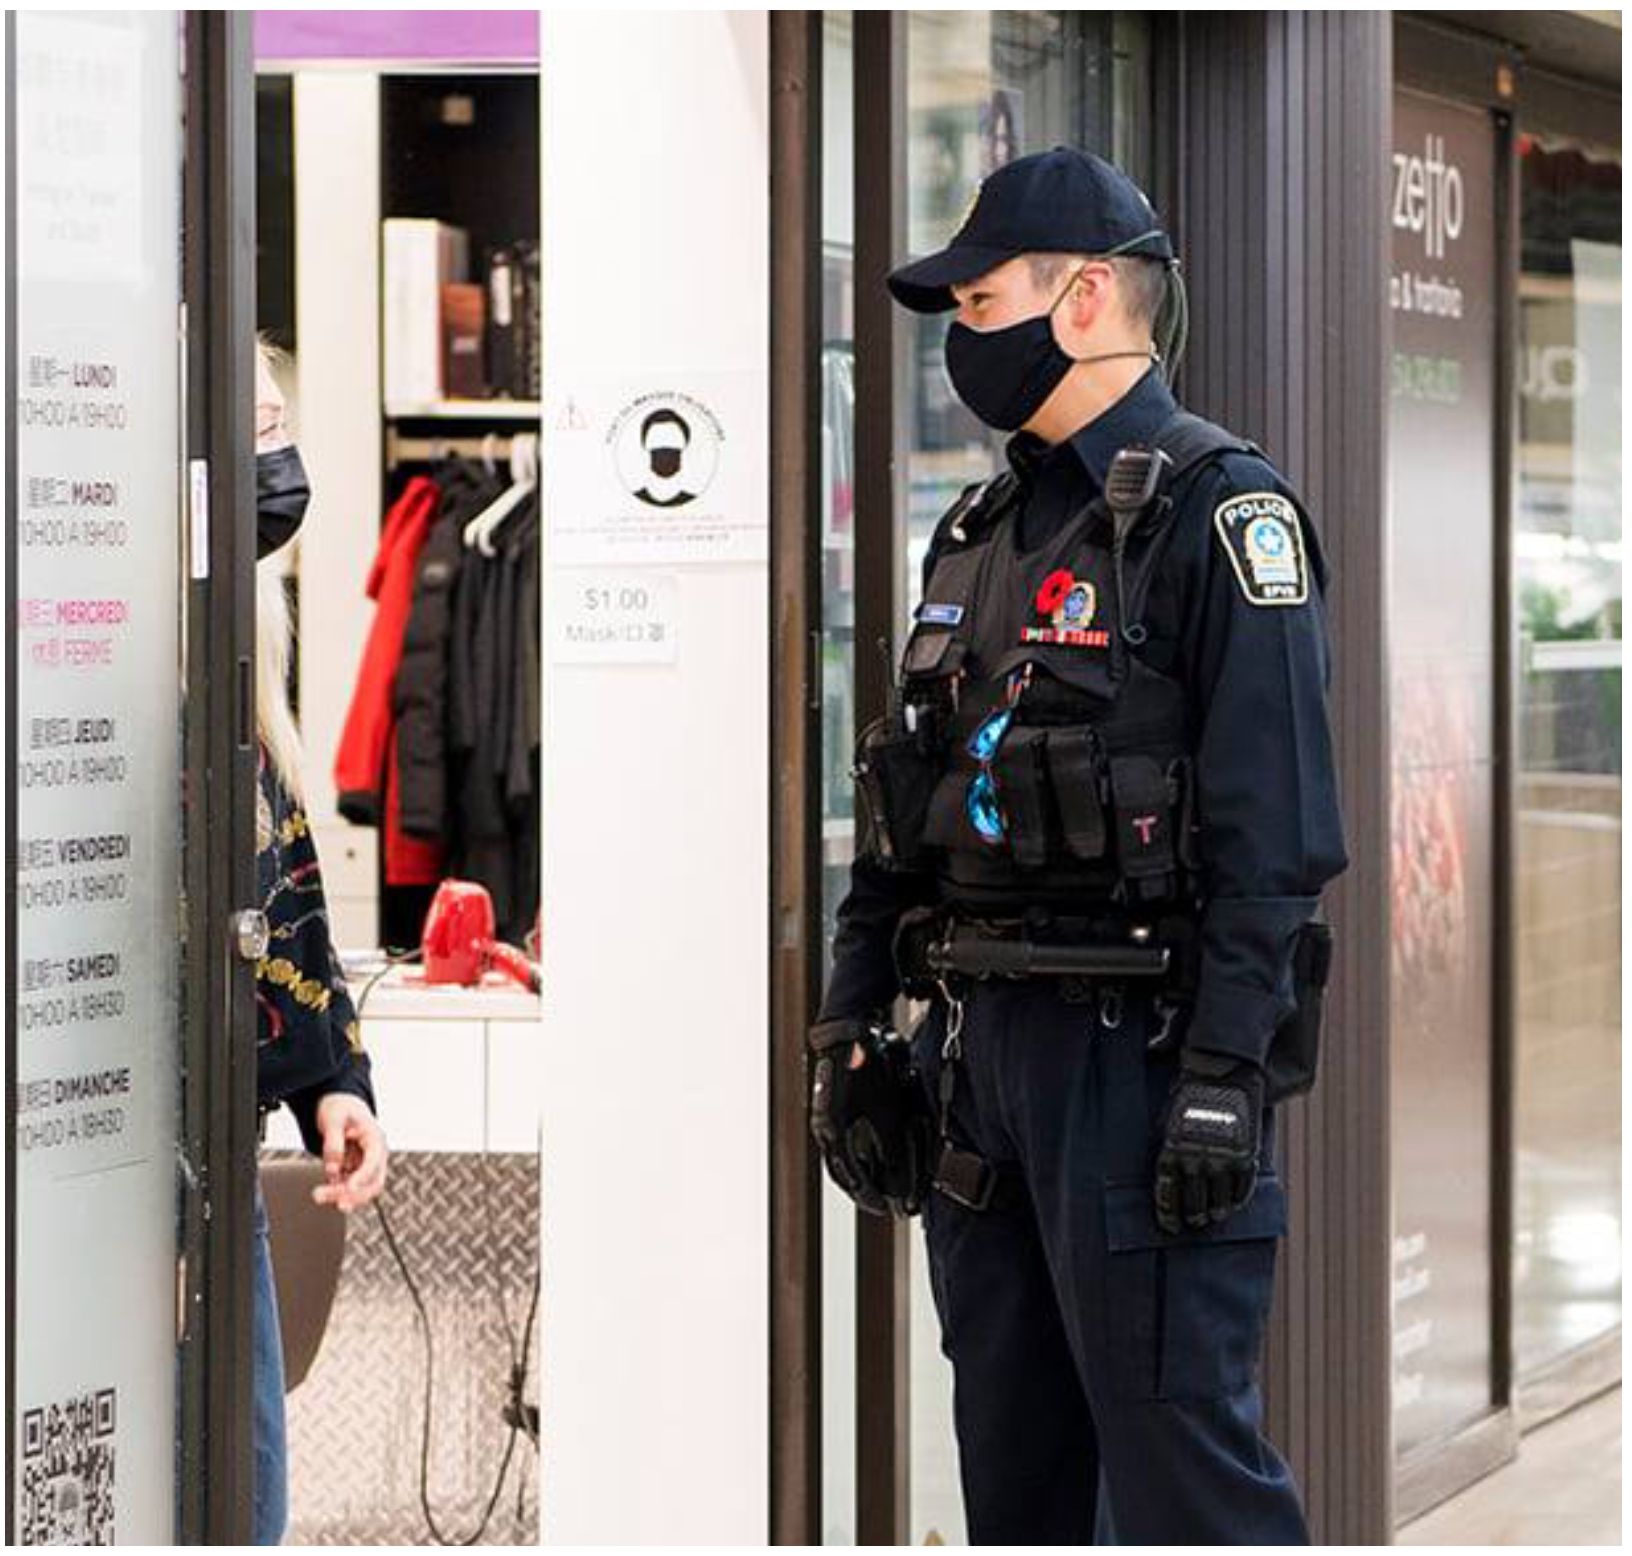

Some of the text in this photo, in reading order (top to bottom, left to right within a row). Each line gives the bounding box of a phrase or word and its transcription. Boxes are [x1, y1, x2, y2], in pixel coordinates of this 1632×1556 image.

[73, 362, 117, 388] LUNDI
[71, 482, 117, 507] MARDI
[1225, 501, 1294, 526] POLICE
[56, 599, 130, 625] MERCREDI
[74, 717, 115, 743] JEUDI
[58, 834, 131, 864] VENDREDI
[67, 953, 120, 984] SAMEDI
[55, 1066, 131, 1105] DIMANCHE
